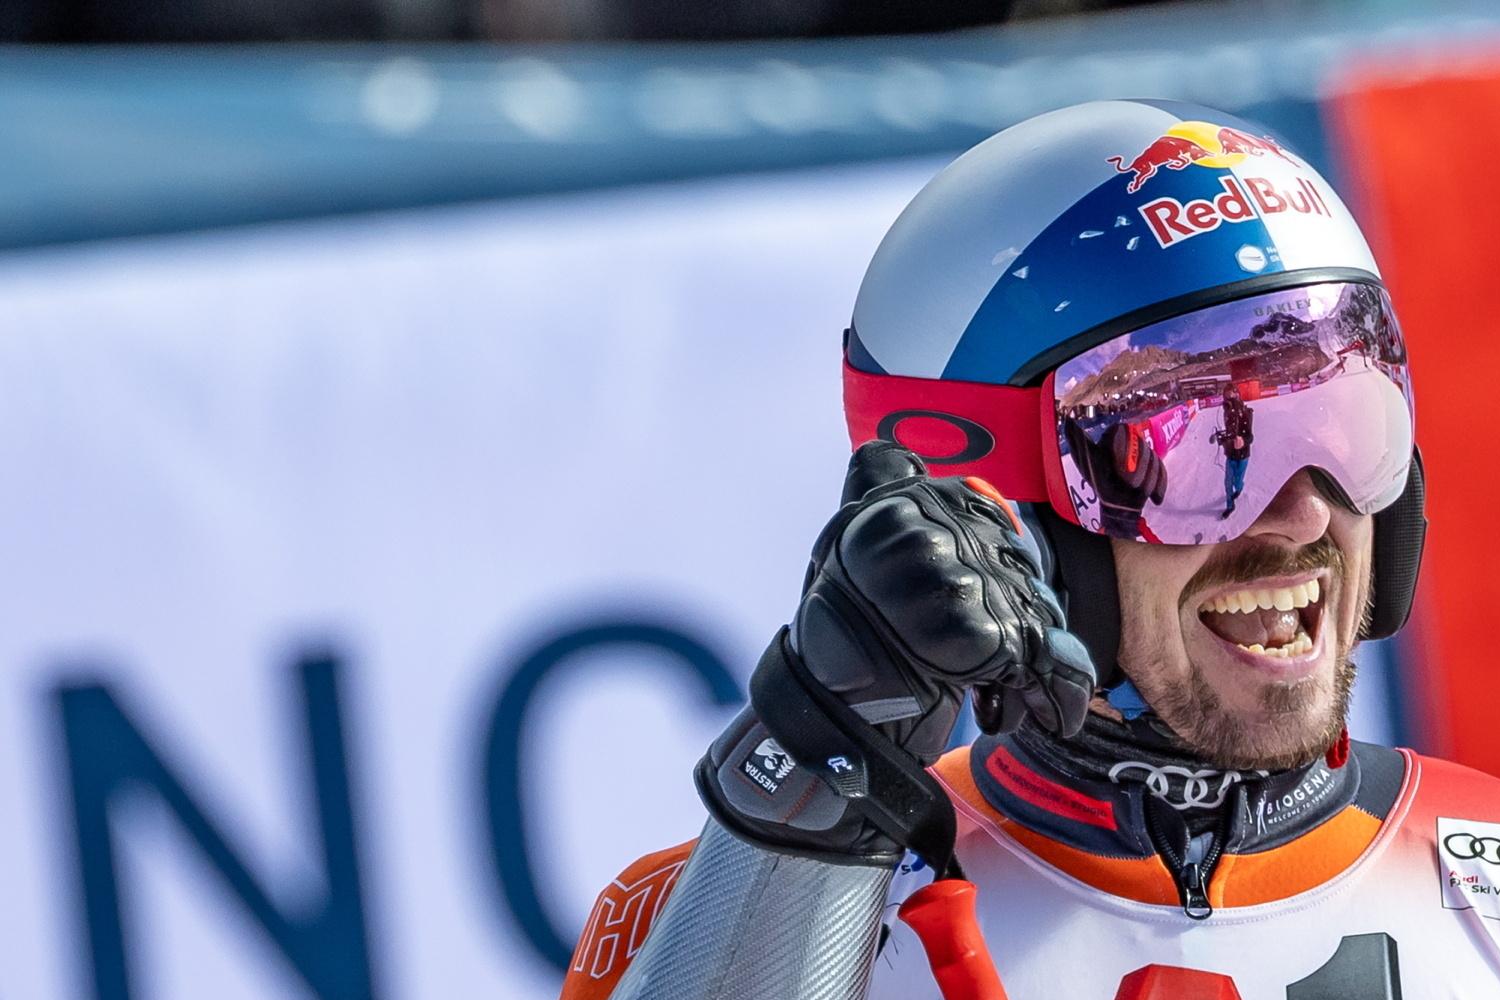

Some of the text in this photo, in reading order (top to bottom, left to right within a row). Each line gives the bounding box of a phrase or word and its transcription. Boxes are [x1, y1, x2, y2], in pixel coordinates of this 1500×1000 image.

[1142, 176, 1333, 246] Red Bull
[1252, 298, 1313, 318] OAKLEY
[744, 760, 778, 793] HESTRA
[1266, 768, 1331, 815] BIOGENA
[1448, 870, 1479, 884] Adi
[1471, 884, 1491, 894] Ski
